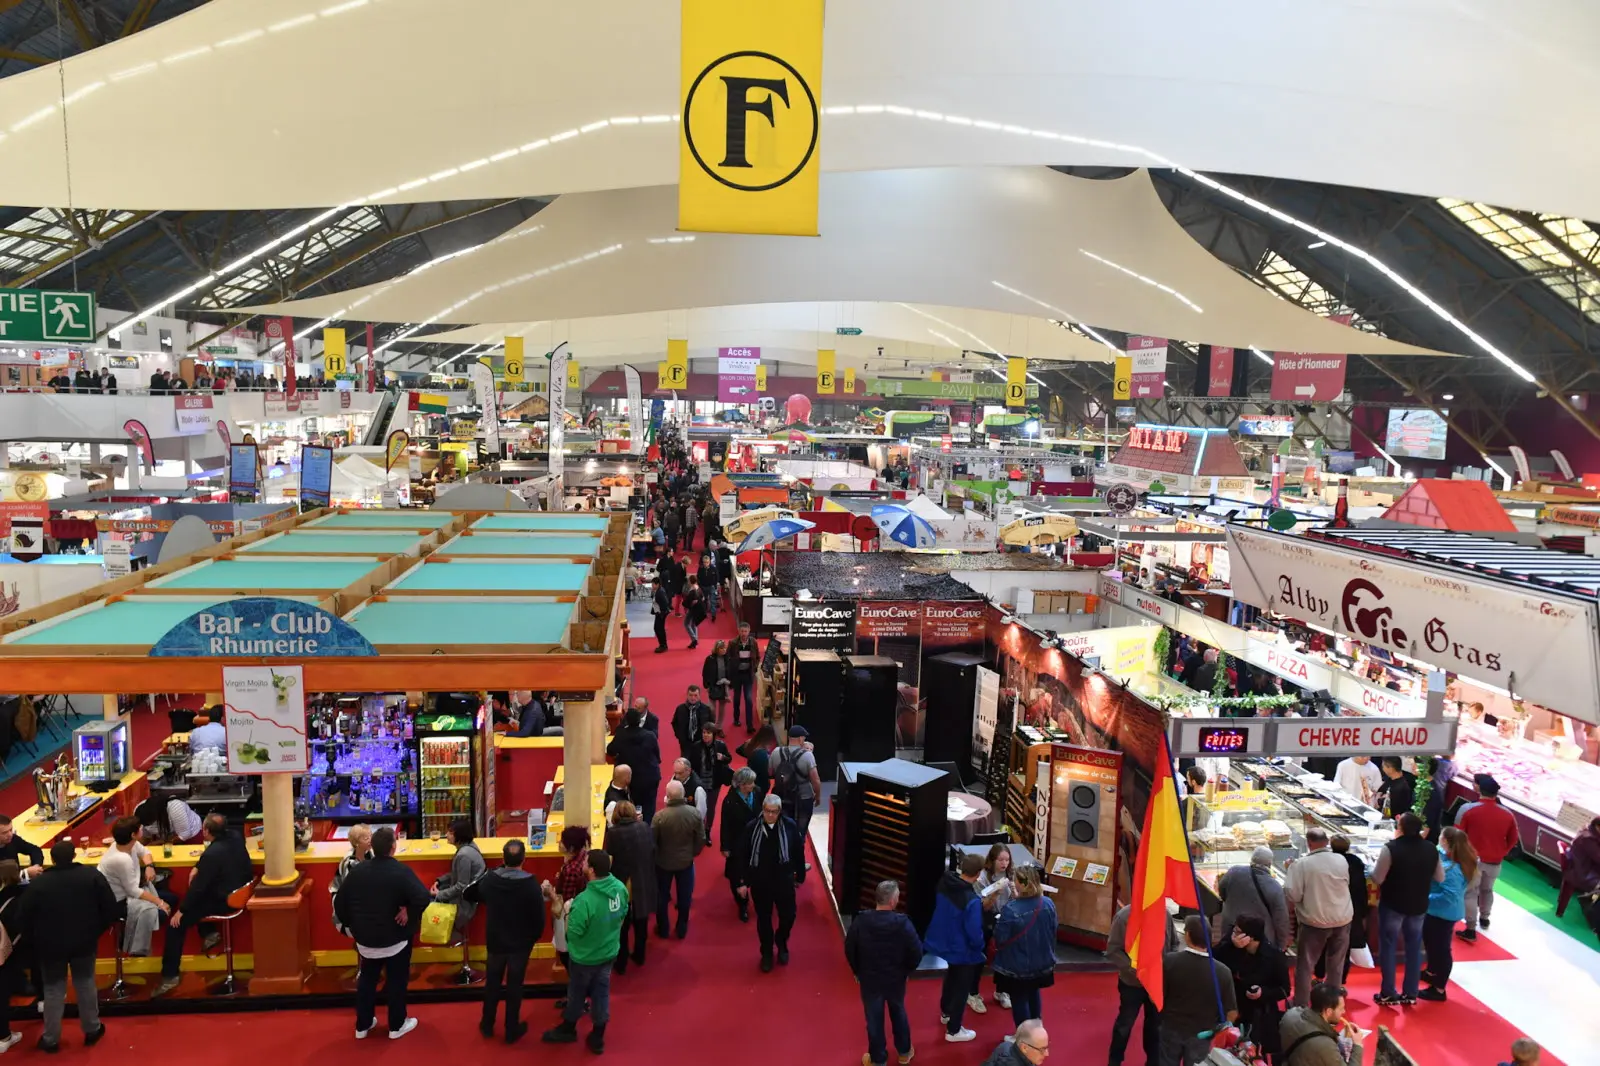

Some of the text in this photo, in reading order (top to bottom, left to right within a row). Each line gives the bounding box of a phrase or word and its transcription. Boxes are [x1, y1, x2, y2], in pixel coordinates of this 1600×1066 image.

[718, 76, 790, 168] F
[727, 347, 752, 356] Accès
[329, 357, 341, 371] H
[507, 362, 519, 375] G
[1279, 358, 1296, 370] Hôte
[672, 367, 682, 380] F
[821, 373, 831, 386] E
[552, 375, 563, 393] Vin
[941, 383, 1002, 398] PAVILLON
[1117, 380, 1127, 392] C
[1011, 386, 1023, 398] D
[1129, 426, 1189, 452] MIAM'
[113, 521, 158, 534] Crêpes
[794, 607, 852, 619] EuroCave
[861, 606, 917, 618] EuroCave
[926, 607, 982, 618] EuroCave
[1136, 597, 1161, 616] nutella
[199, 613, 244, 635] Bar
[270, 611, 332, 634] Club
[1278, 574, 1330, 622] Alby
[1424, 617, 1502, 672] Gras
[210, 636, 318, 654] Rhumerie
[1267, 650, 1308, 680] PIZZA
[225, 679, 268, 688] Virgin Mojito
[230, 717, 254, 727] Mojito
[1206, 734, 1243, 747] FRITES
[1298, 727, 1428, 747] CHEVRE CHAUD
[1056, 748, 1116, 767] EuroCave
[1101, 772, 1117, 780] Cave
[1036, 790, 1047, 861] NOUVE
